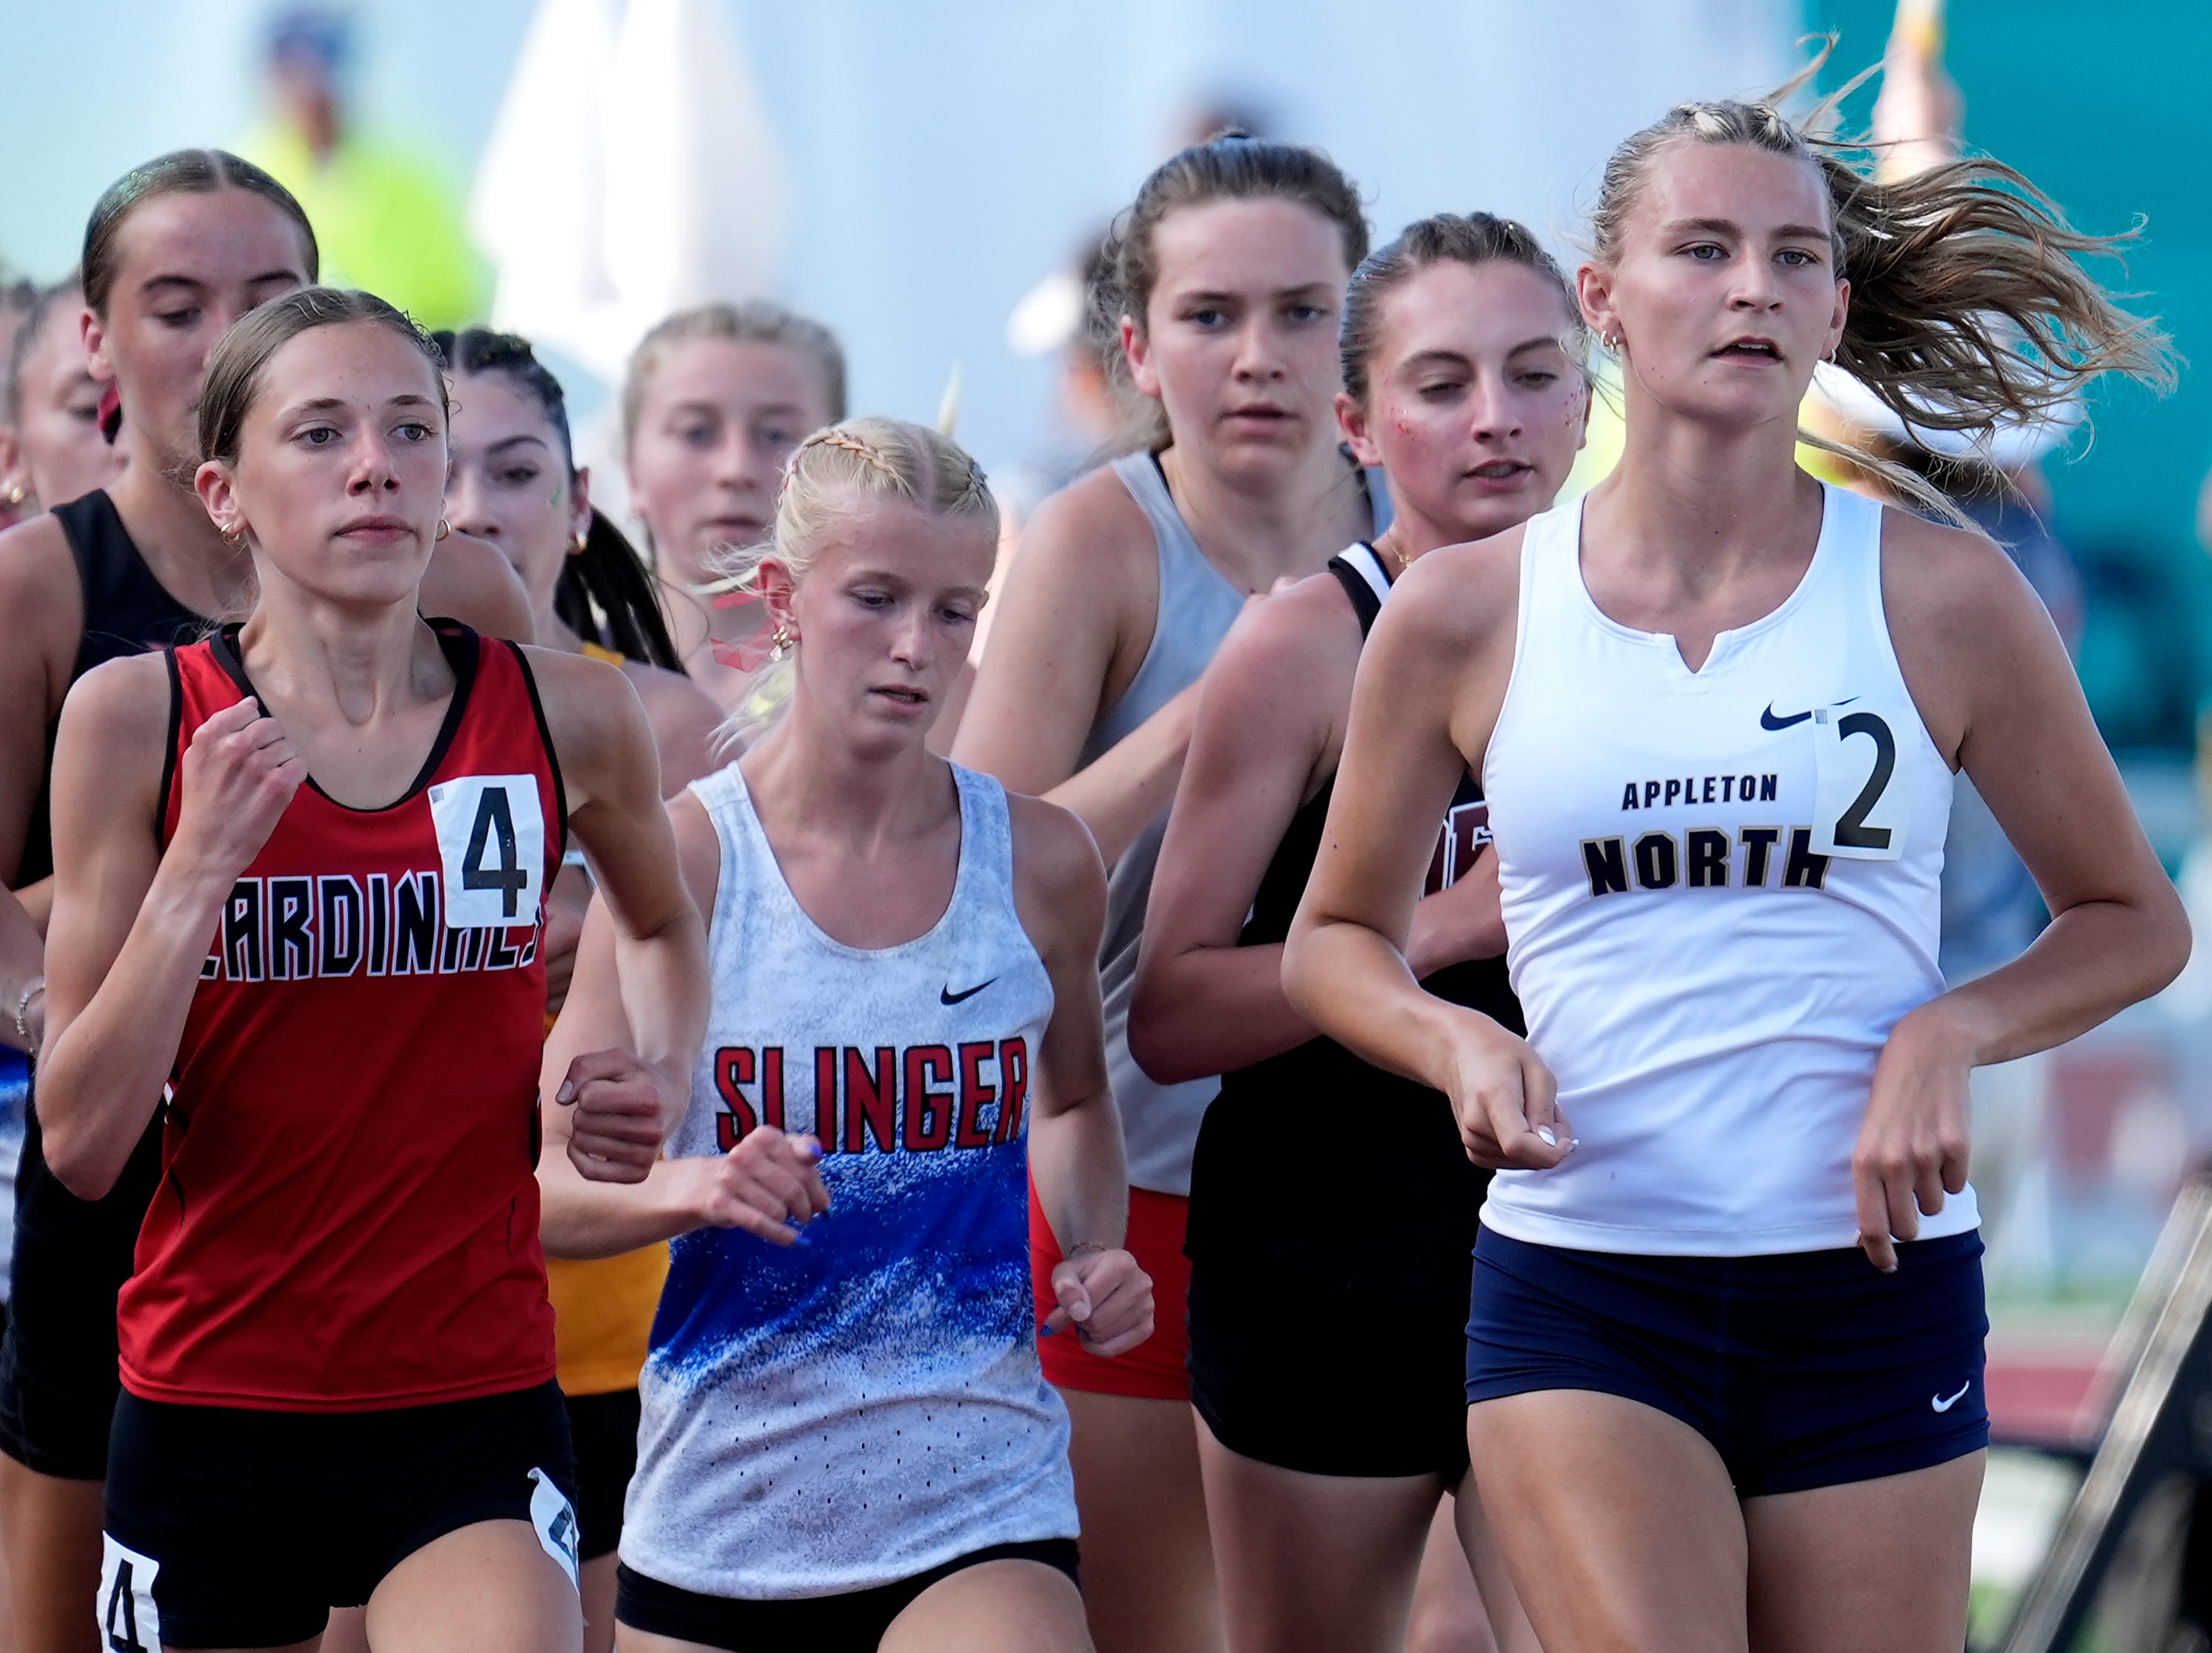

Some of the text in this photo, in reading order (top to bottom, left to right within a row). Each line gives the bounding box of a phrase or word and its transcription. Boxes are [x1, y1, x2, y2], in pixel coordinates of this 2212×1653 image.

[1621, 773, 1778, 811] APPLETON
[1833, 712, 1896, 849] 2
[462, 787, 527, 917] 4
[1579, 825, 1832, 897] NORTH
